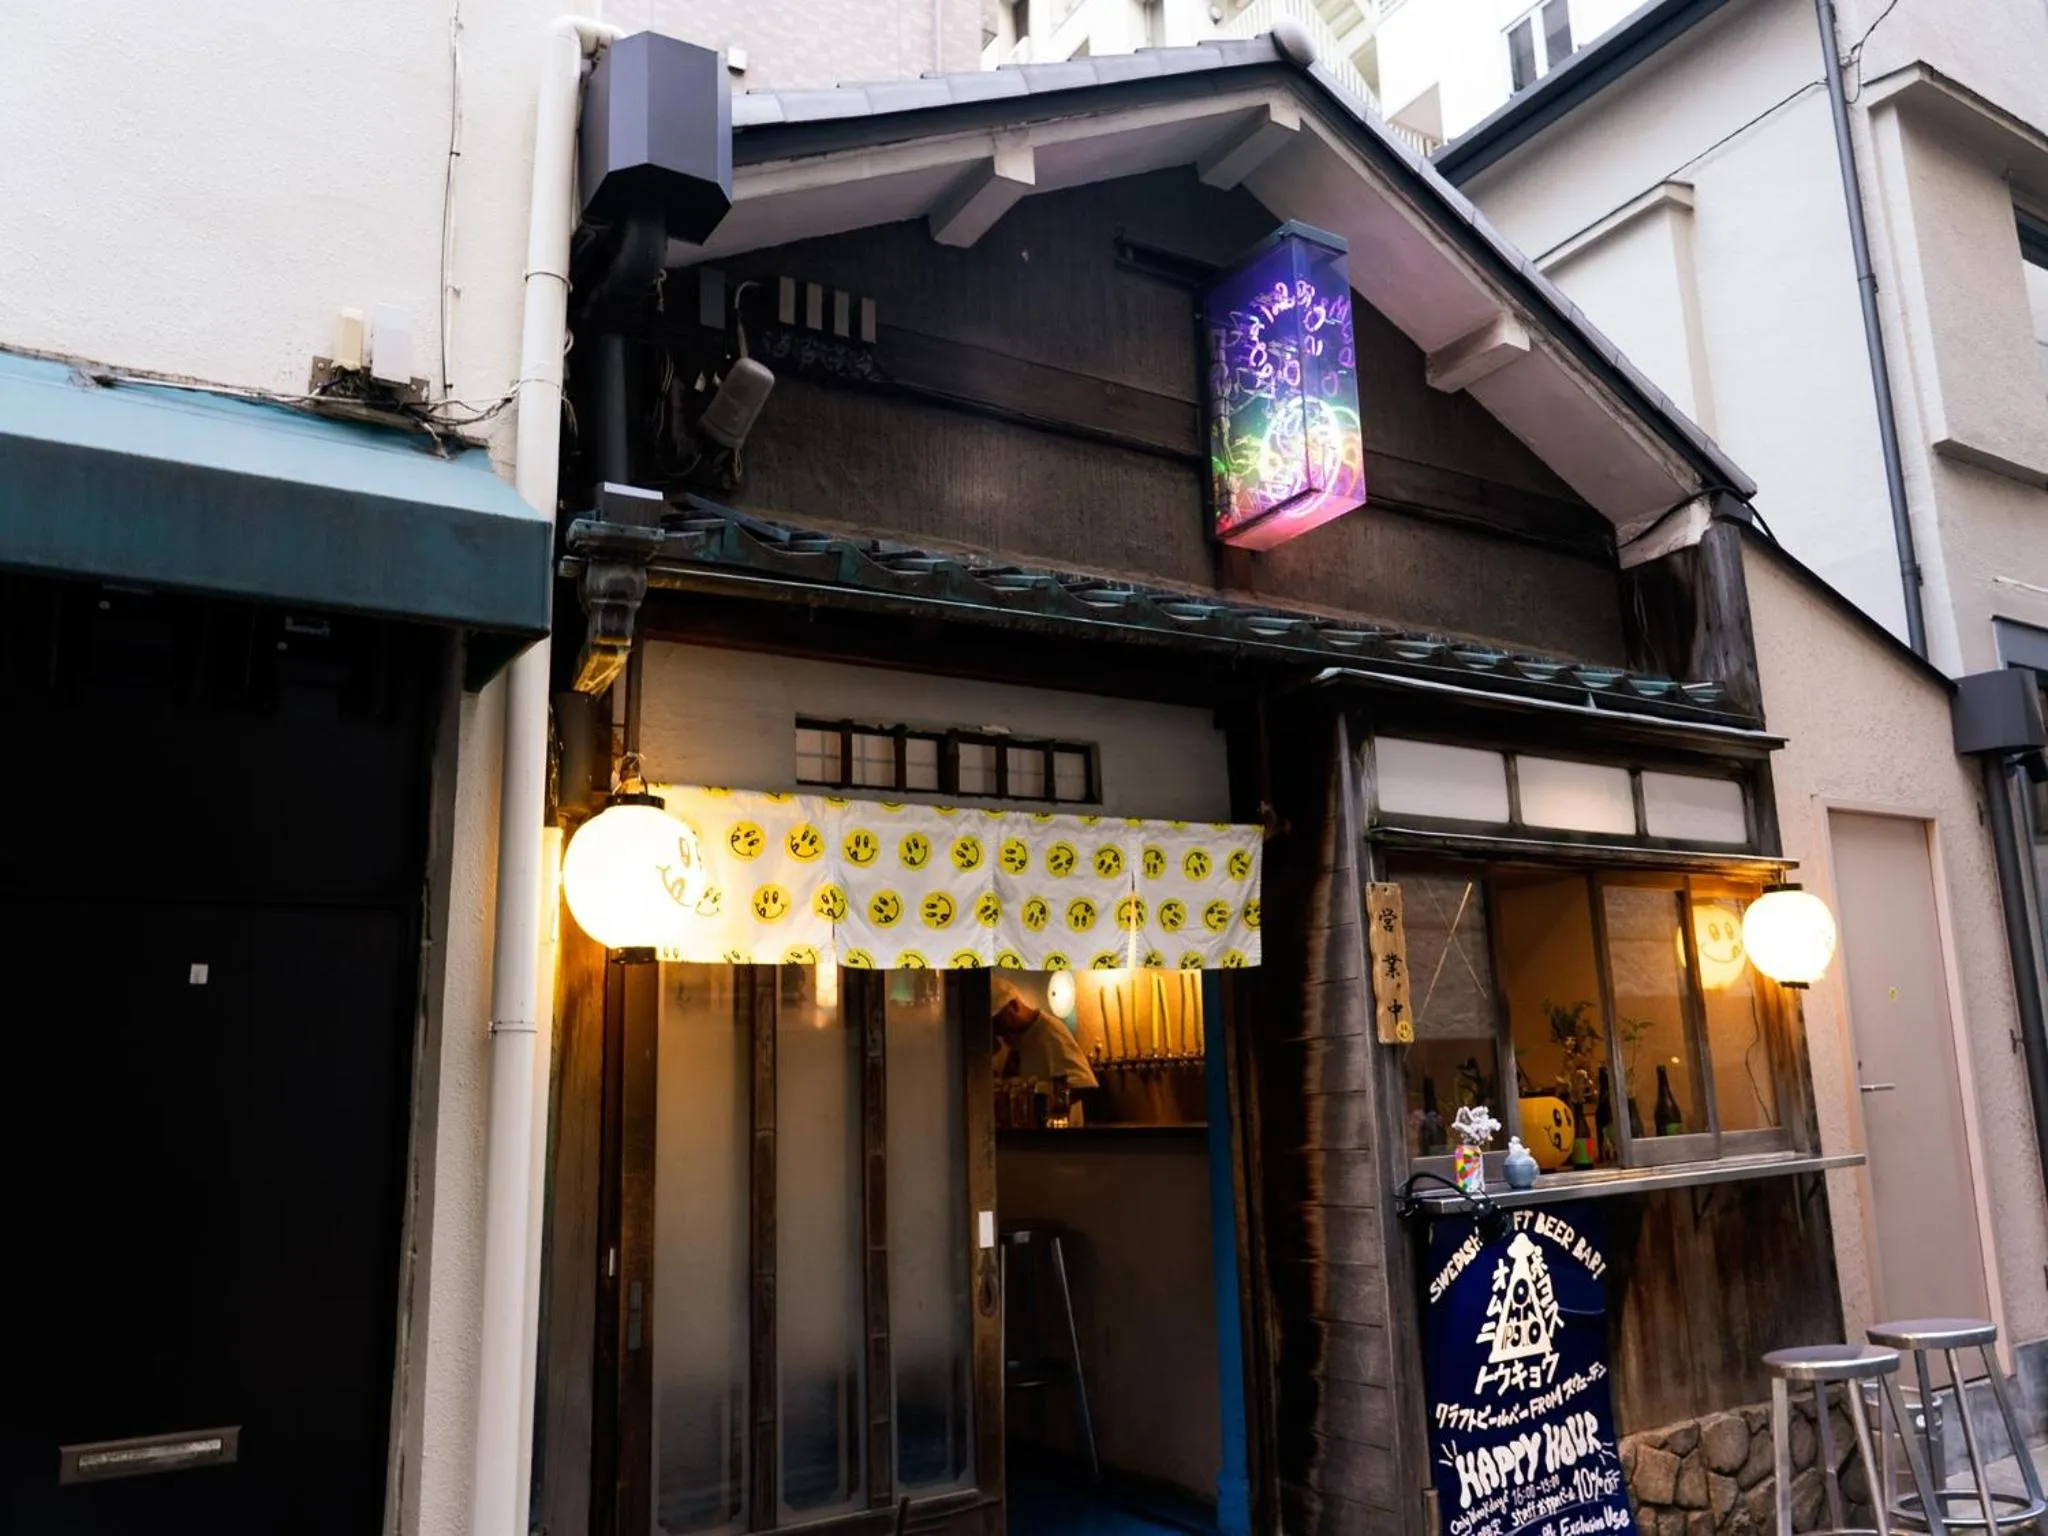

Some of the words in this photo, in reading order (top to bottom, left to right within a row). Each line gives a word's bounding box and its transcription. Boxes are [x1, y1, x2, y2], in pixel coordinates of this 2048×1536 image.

[1534, 1211, 1575, 1250] BEER
[1571, 1236, 1607, 1281] BAR!
[1475, 1258, 1510, 1344] オムニ
[1474, 1352, 1560, 1396] トウキョウ
[1455, 1432, 1541, 1509] HAPPY
[1542, 1411, 1602, 1473] HOUR
